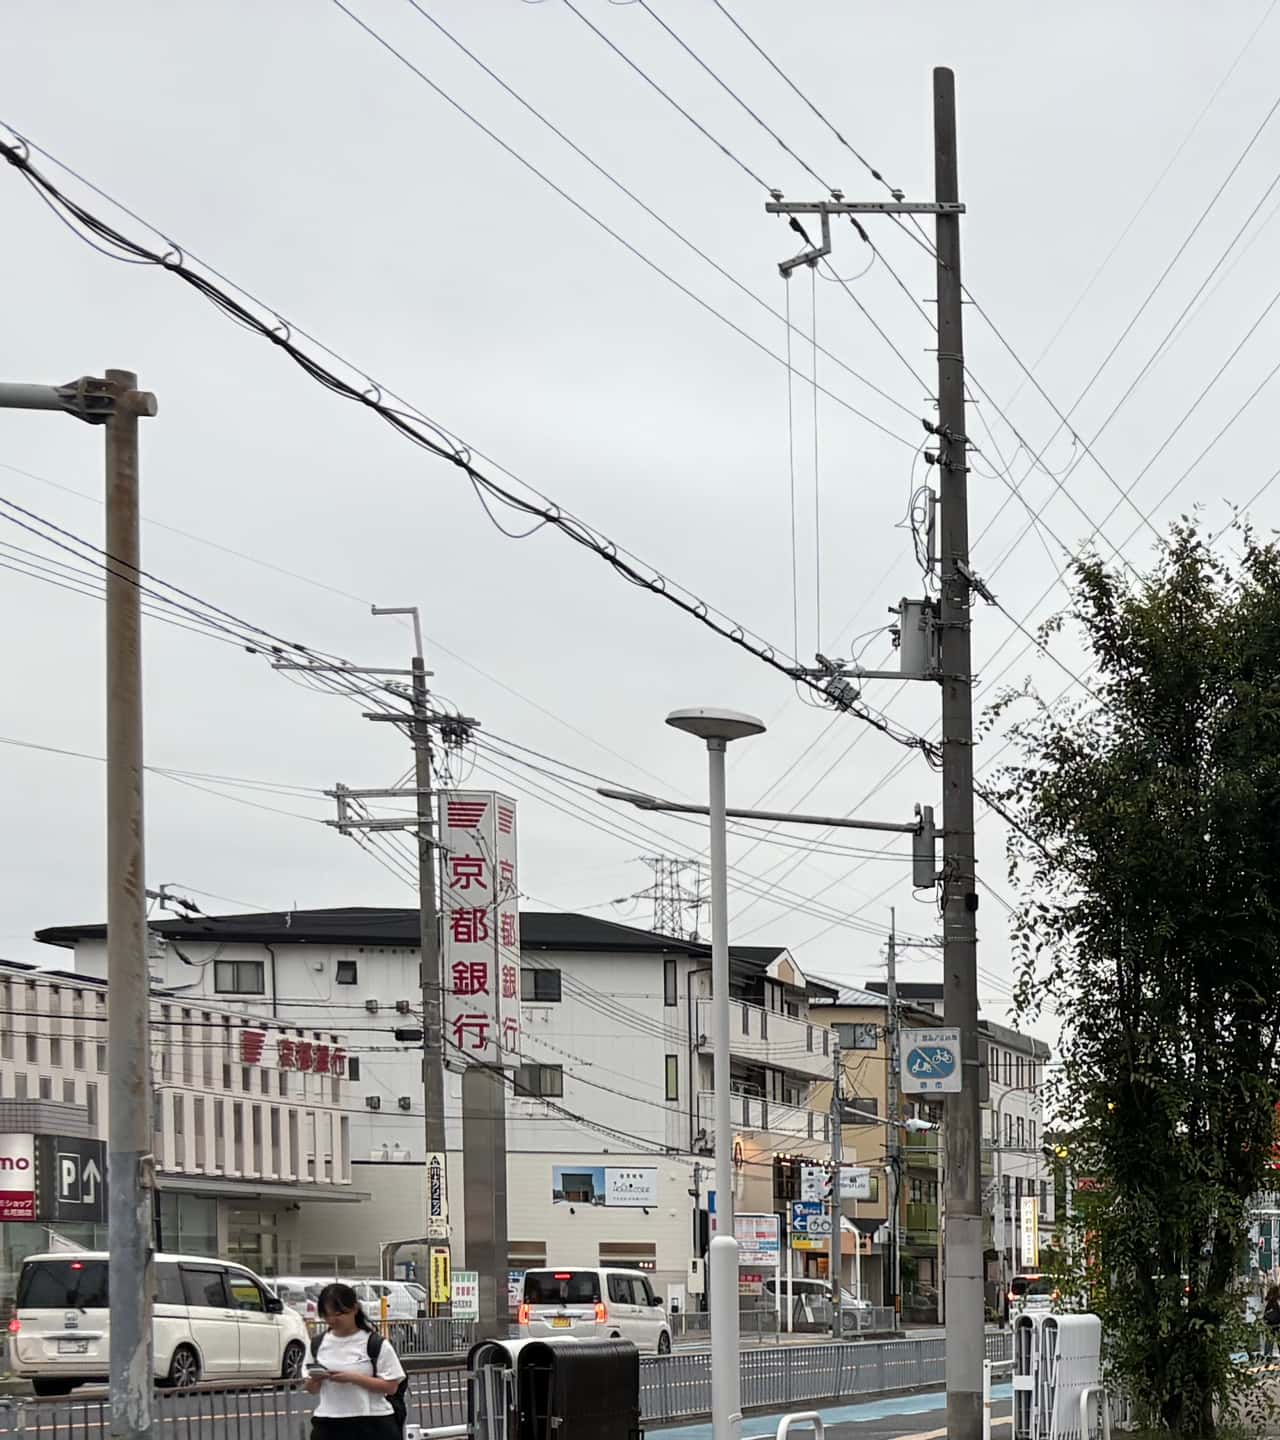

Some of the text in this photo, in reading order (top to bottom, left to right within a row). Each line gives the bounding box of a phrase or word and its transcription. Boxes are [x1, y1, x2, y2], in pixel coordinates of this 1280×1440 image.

[449, 854, 491, 1050] 京都銀行
[499, 858, 518, 1053] 京都銀行
[278, 1038, 347, 1076] 京都銀行
[61, 1159, 76, 1196] P
